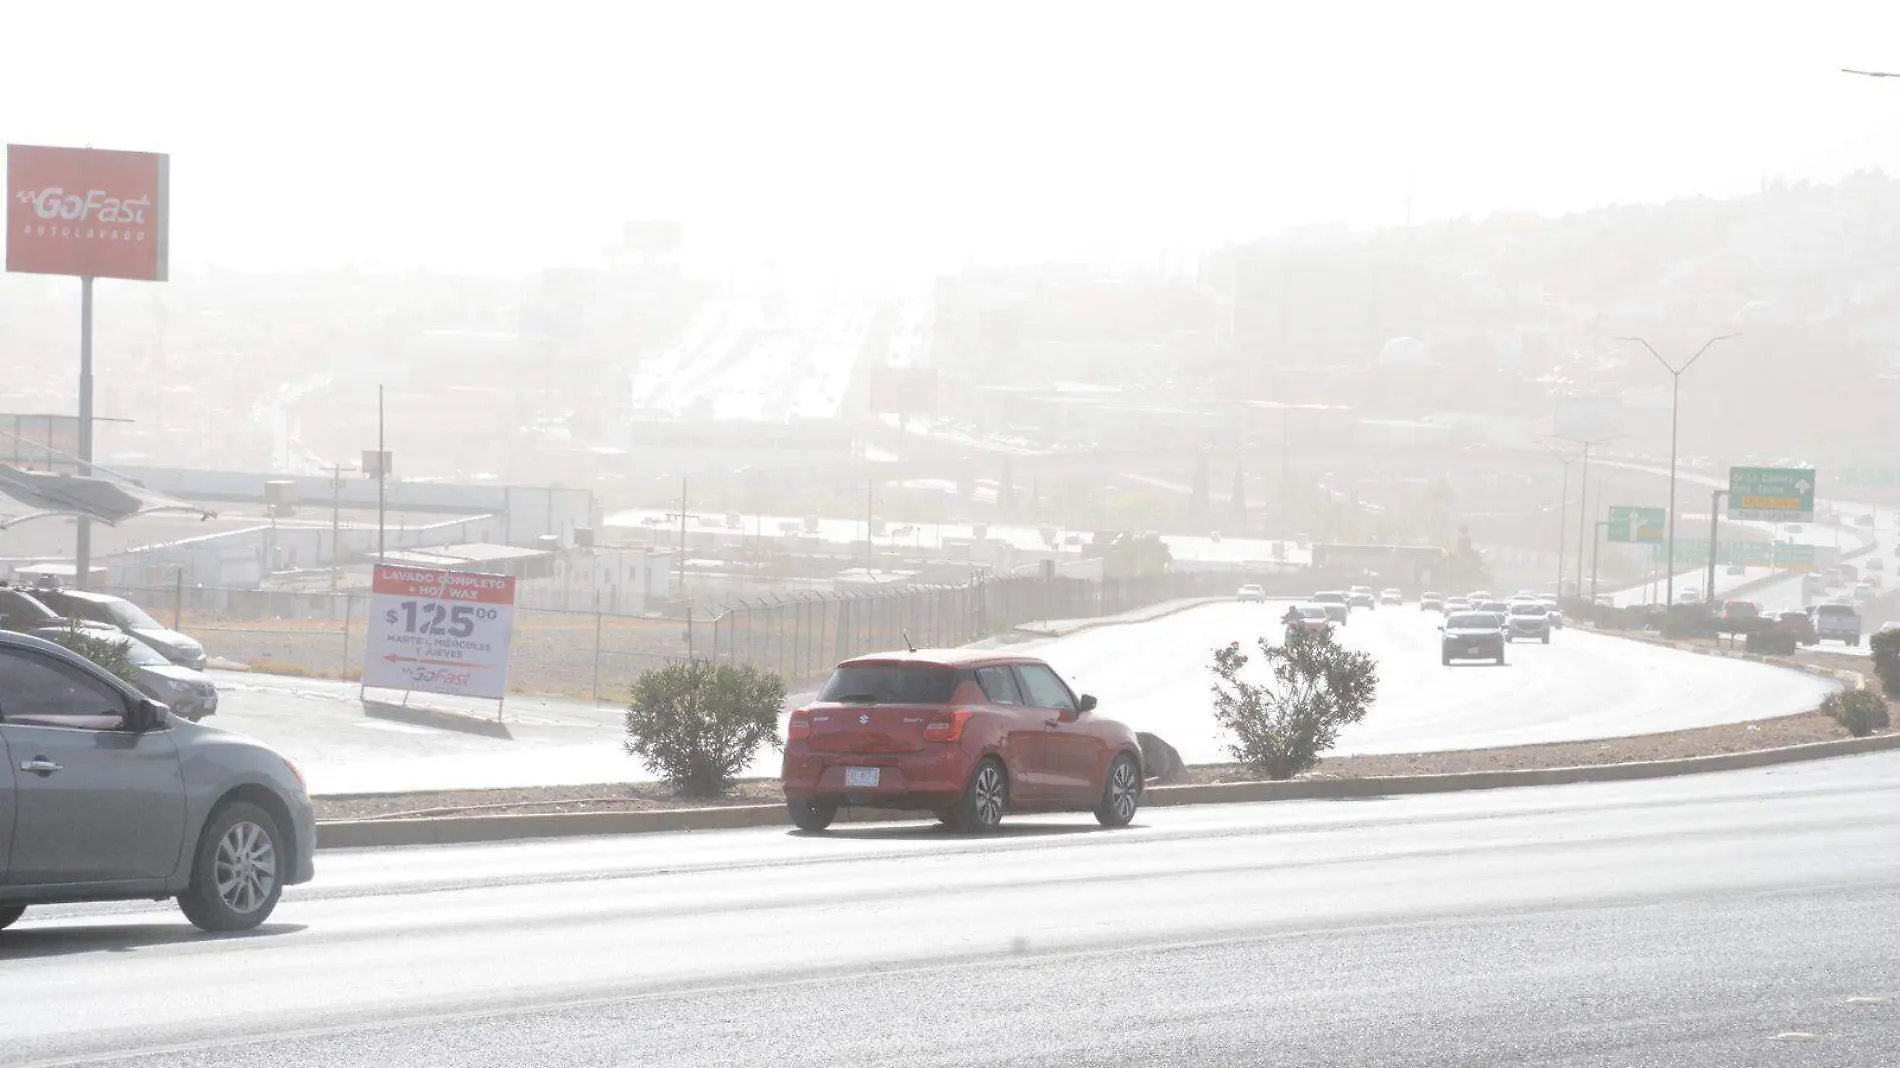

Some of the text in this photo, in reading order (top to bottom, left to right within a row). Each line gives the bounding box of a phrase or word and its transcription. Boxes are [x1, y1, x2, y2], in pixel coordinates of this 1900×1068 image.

[34, 187, 150, 224] GoFast
[24, 224, 145, 242] AUTOLAVADO
[382, 571, 506, 589] LAVADO COMPLETO
[449, 590, 478, 599] WAX
[424, 648, 463, 659] JUEVES
